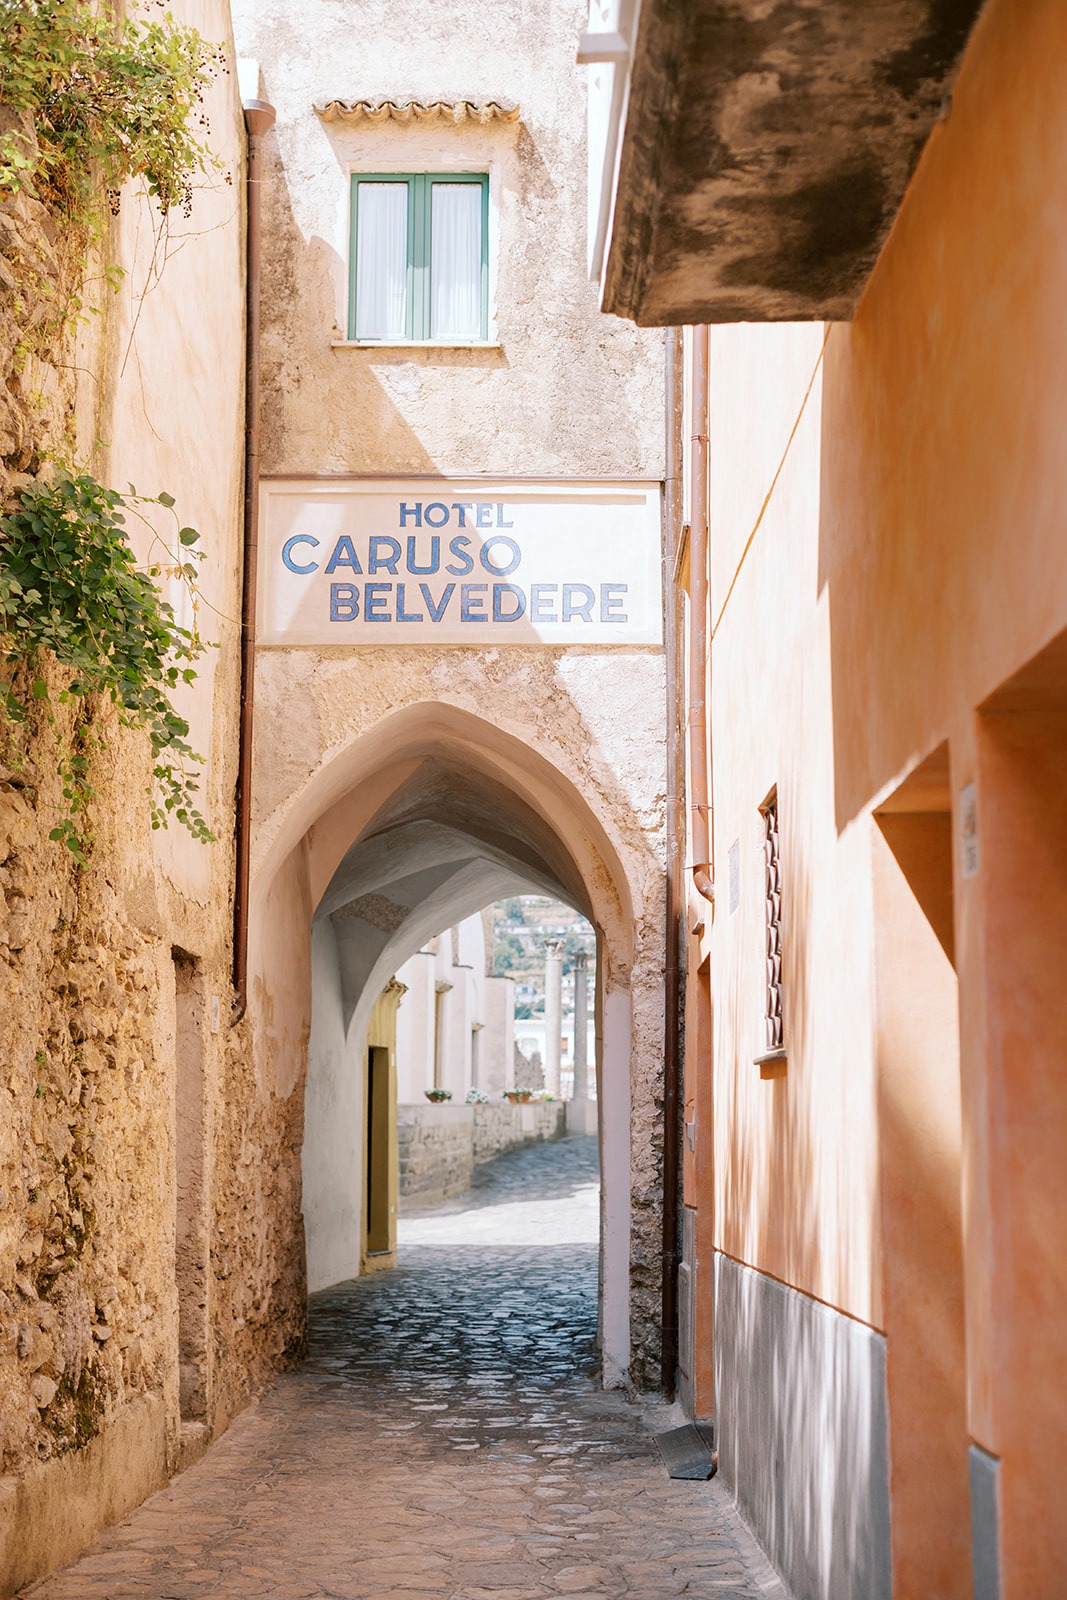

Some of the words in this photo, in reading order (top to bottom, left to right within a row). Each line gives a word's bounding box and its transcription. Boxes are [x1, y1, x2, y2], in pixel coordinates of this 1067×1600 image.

[399, 502, 514, 528] HOTEL
[281, 534, 522, 576] CARUSO
[330, 583, 628, 622] BELVEDERE
